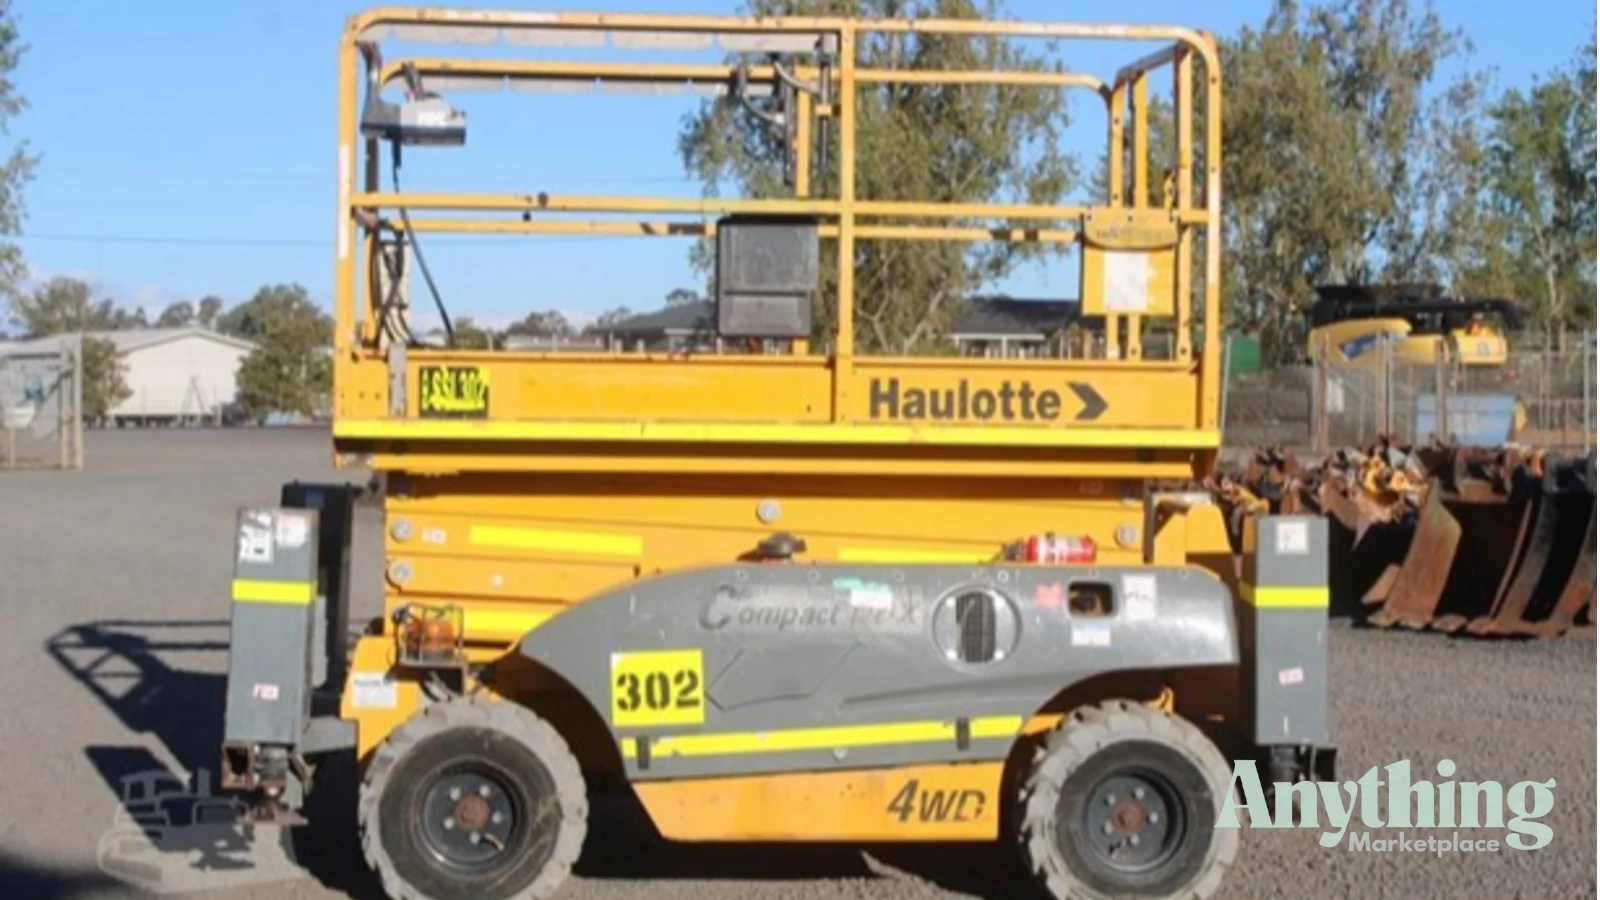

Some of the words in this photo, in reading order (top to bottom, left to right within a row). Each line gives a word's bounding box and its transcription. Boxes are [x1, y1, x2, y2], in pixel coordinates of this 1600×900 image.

[868, 377, 1062, 420] Haulotte
[699, 583, 841, 632] Compact
[617, 669, 700, 712] 302
[886, 779, 987, 822] 4WD
